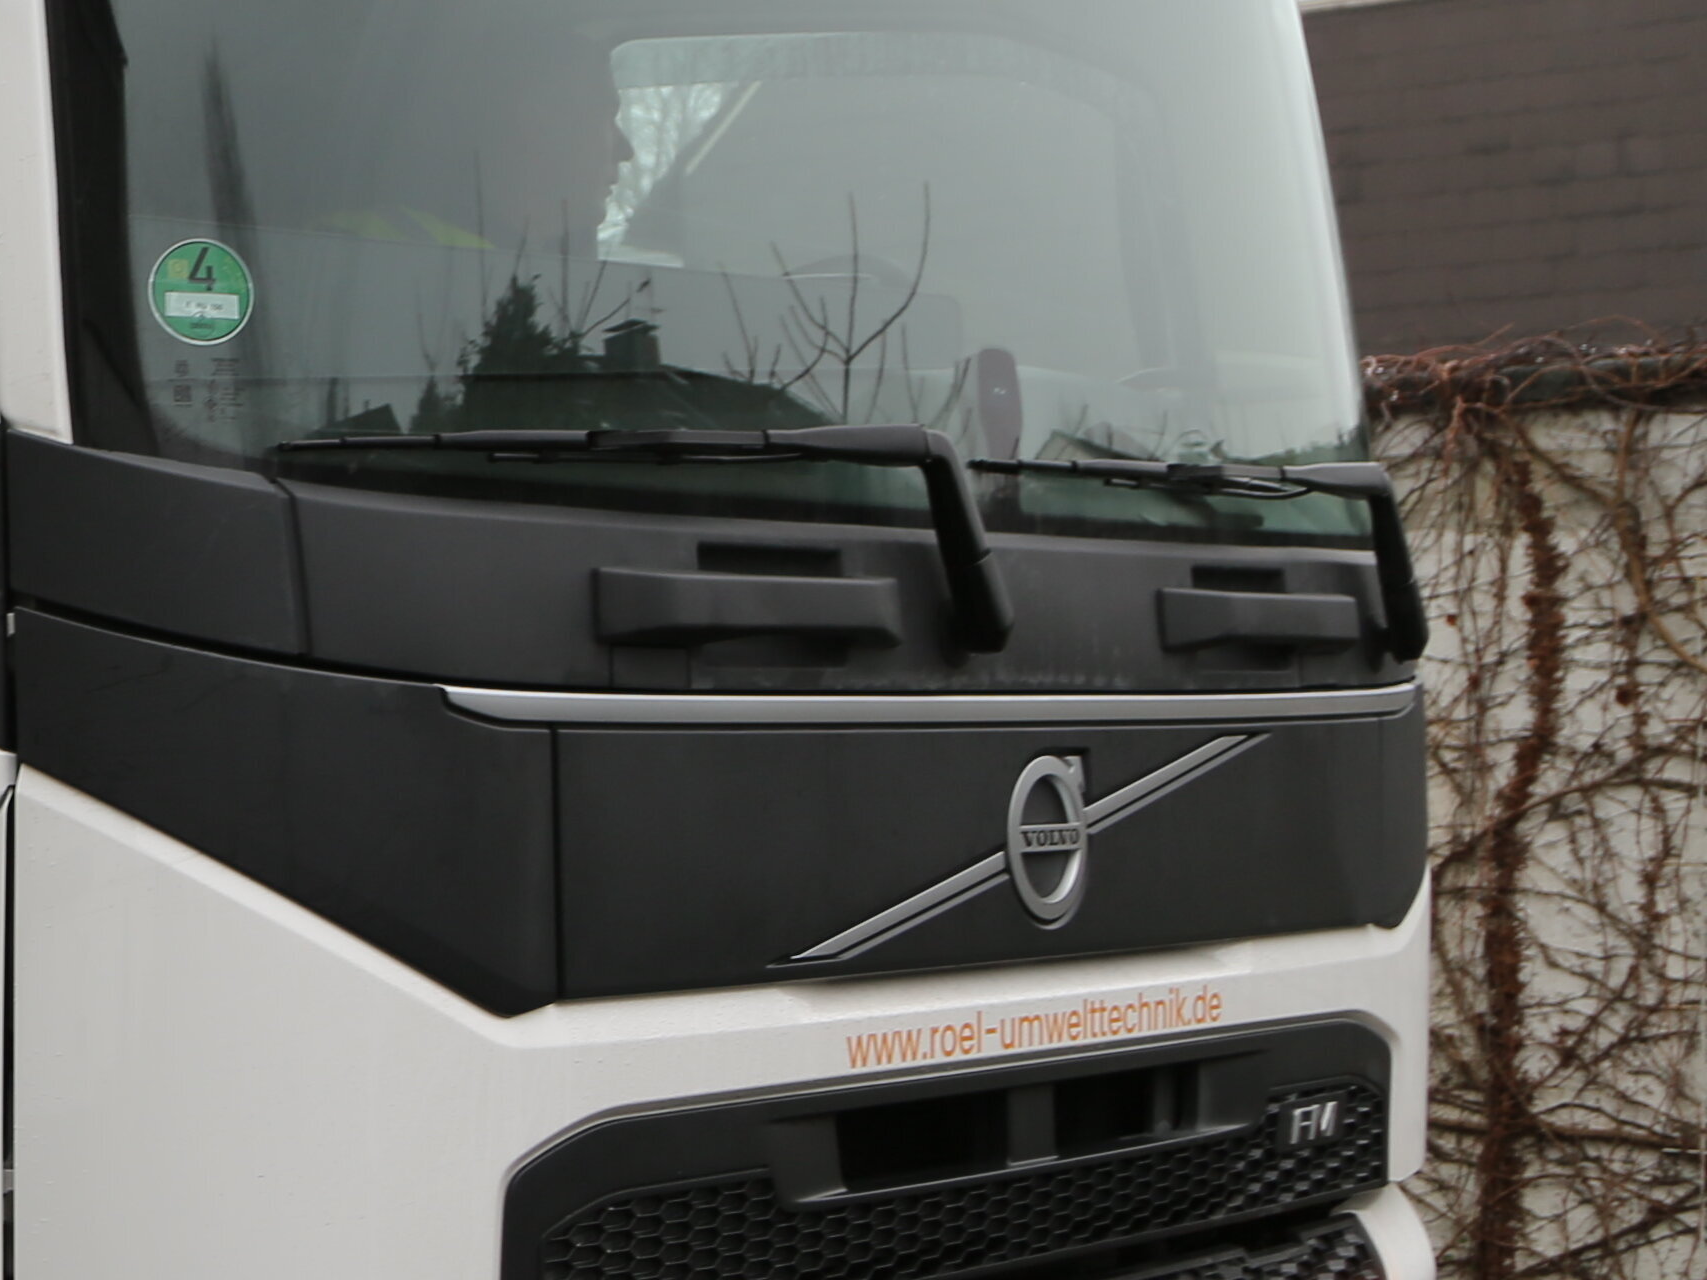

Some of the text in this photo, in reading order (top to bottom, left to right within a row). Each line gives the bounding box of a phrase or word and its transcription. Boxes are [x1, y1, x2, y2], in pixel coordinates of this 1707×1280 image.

[188, 246, 216, 292] 4
[1019, 828, 1080, 847] VOLVO
[846, 984, 1223, 1068] www.roel-umwelttechnik.de
